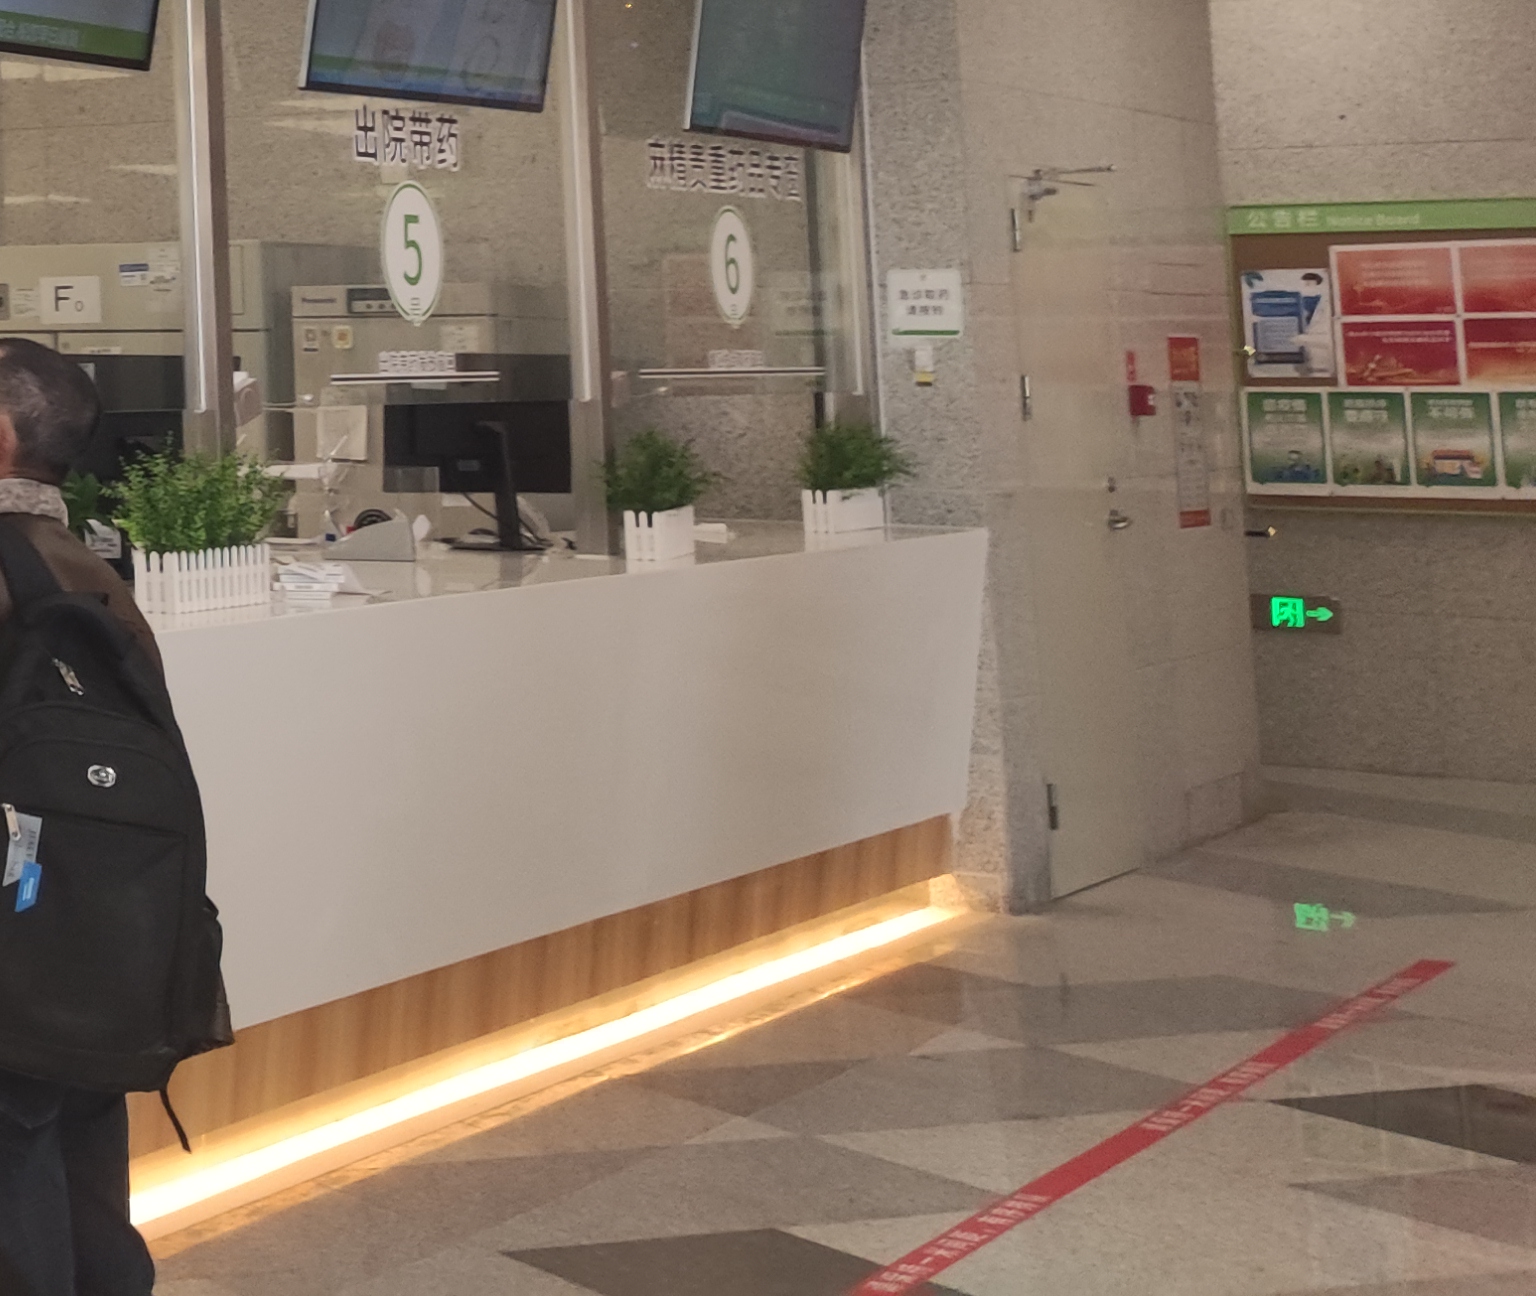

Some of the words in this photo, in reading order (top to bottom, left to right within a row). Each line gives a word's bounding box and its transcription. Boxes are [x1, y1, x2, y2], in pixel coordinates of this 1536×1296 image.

[353, 104, 461, 172] 出院带药
[403, 214, 424, 286] 5
[724, 233, 740, 295] 6
